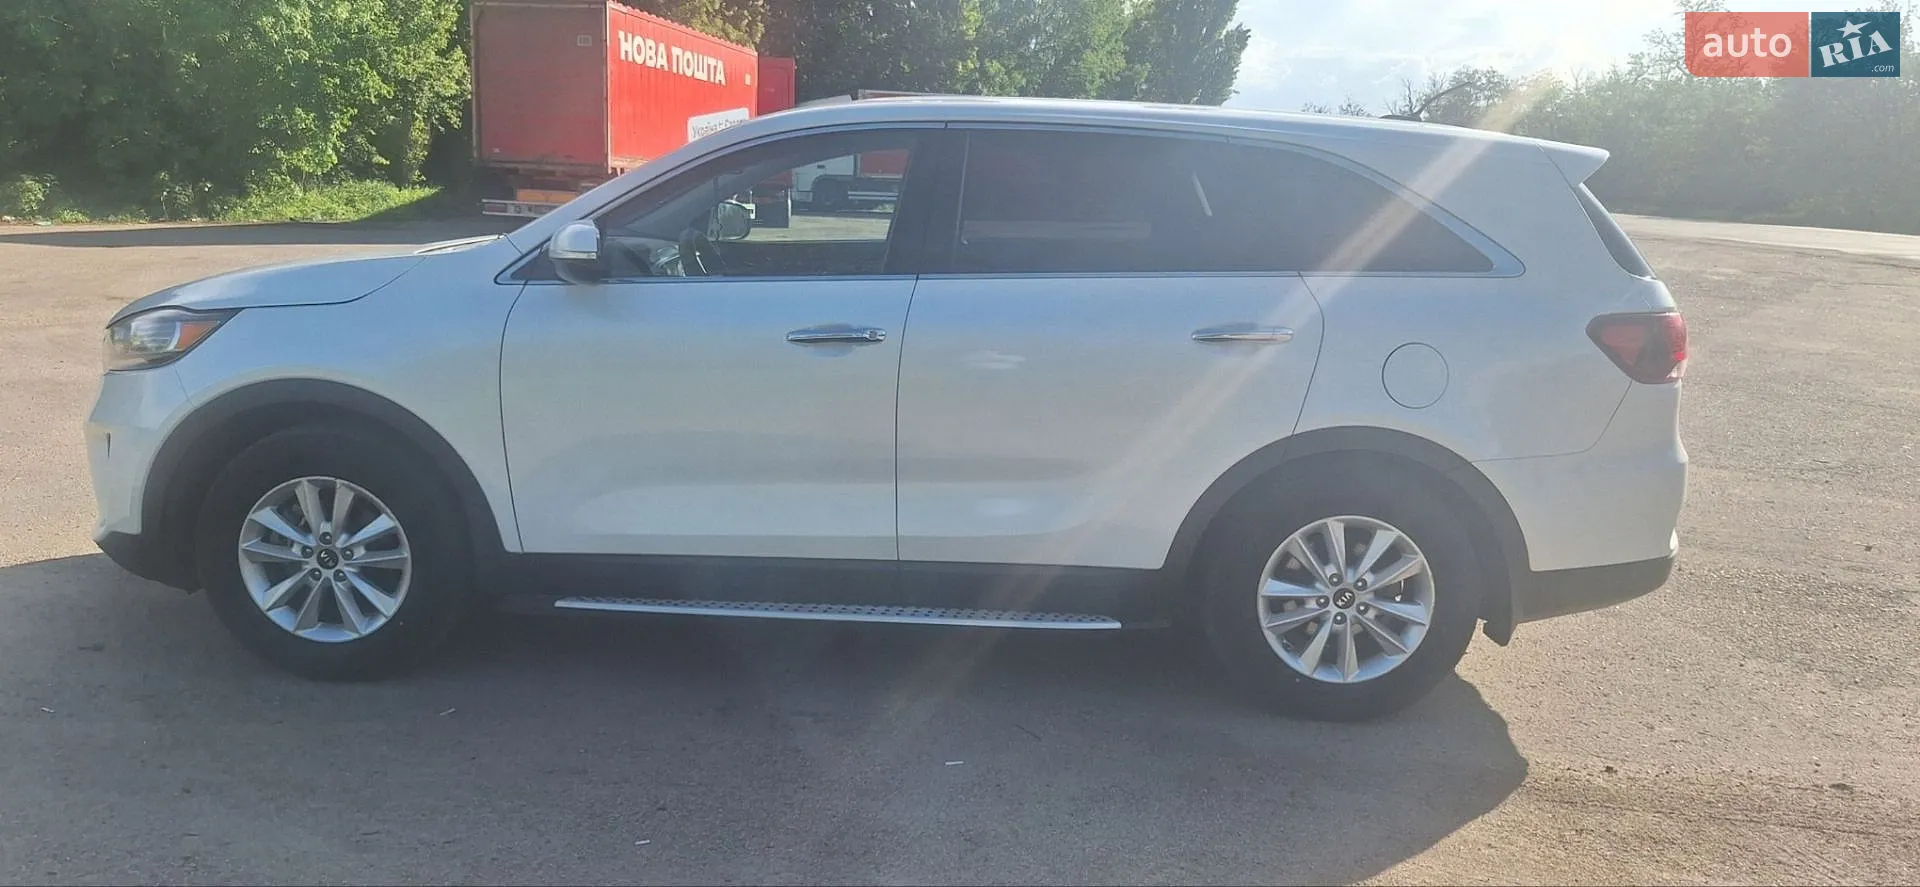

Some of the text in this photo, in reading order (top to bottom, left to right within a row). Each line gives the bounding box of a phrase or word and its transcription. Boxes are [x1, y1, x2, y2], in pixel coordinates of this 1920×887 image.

[618, 30, 727, 86] НОВА ПОШТА
[1336, 592, 1353, 607] KIA
